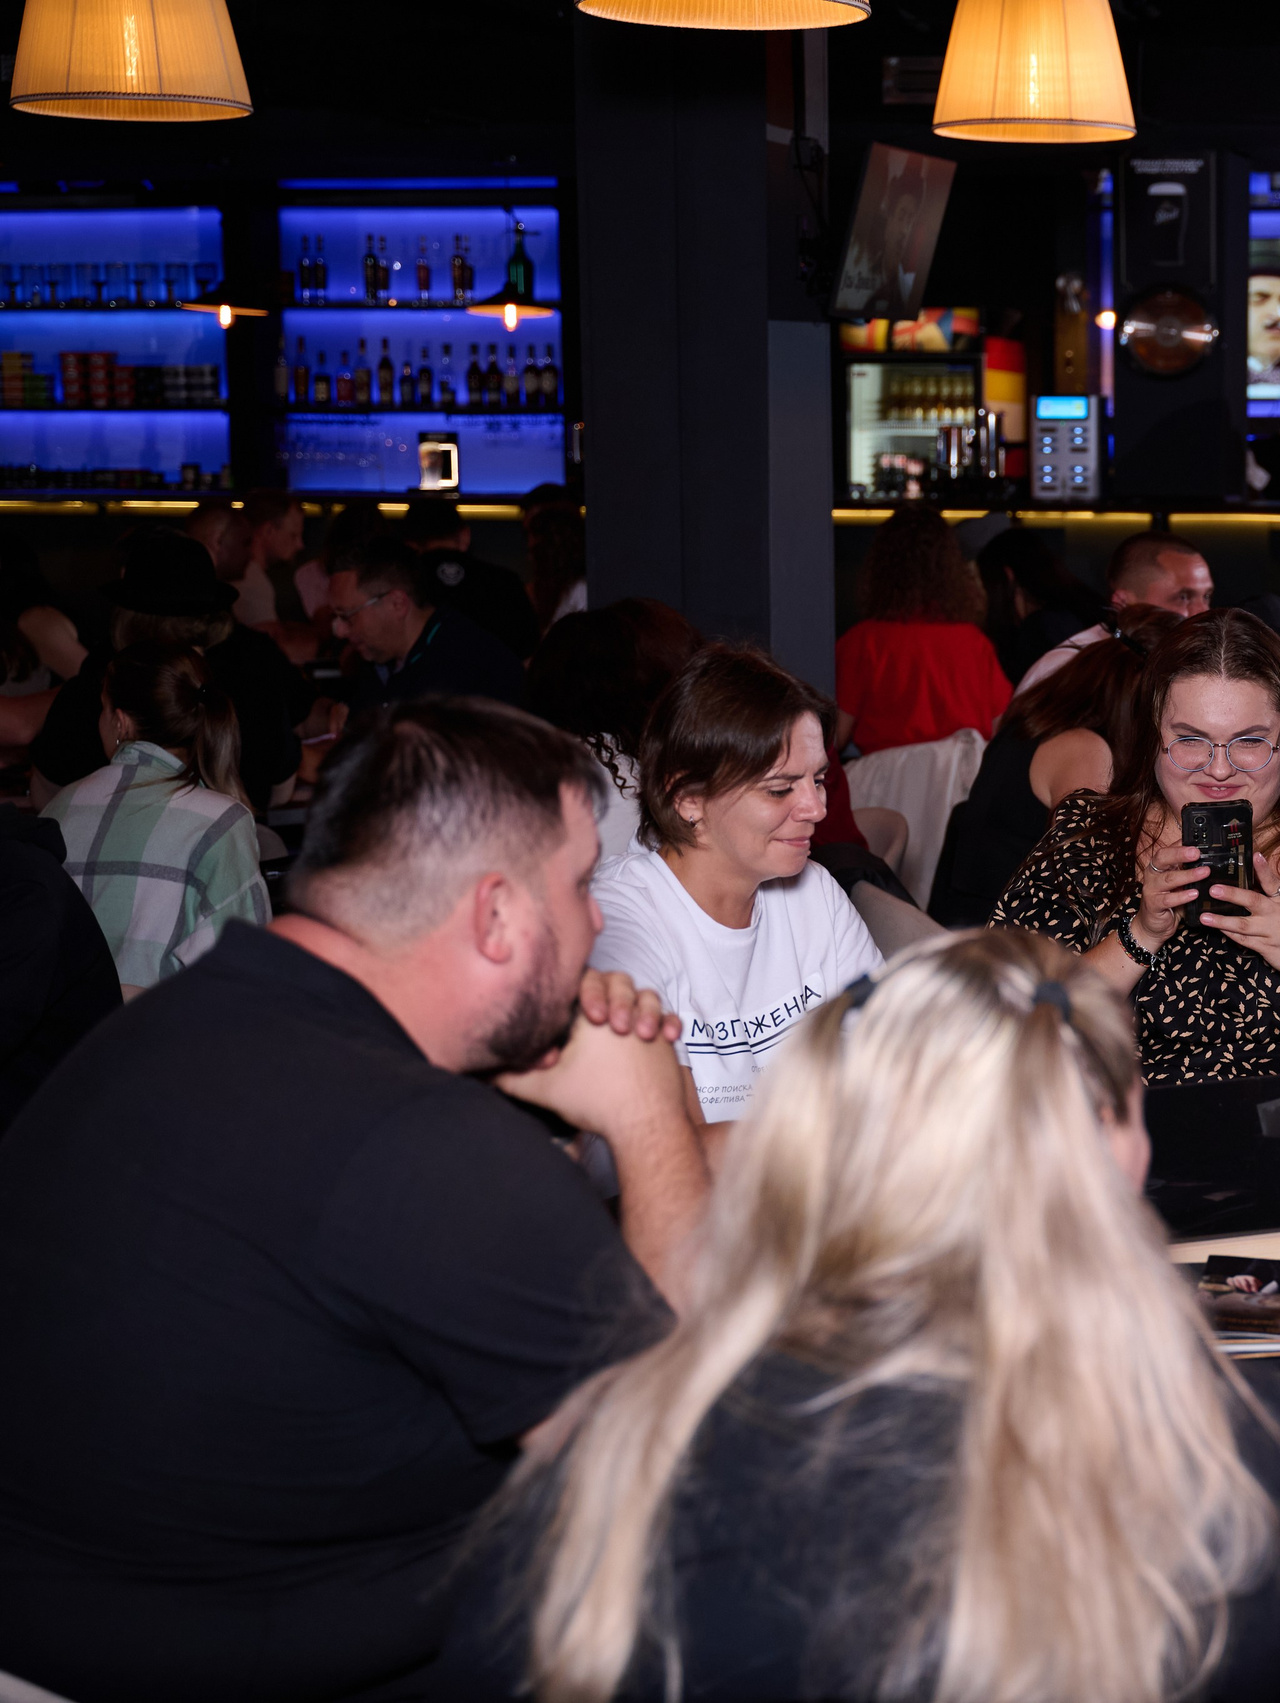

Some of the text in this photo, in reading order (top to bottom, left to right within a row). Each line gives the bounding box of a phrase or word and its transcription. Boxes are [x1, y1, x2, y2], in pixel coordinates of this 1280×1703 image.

[696, 1084, 753, 1094] НСОР ПОИСКА
[699, 1095, 746, 1104] ОФЕ/ПИВА
